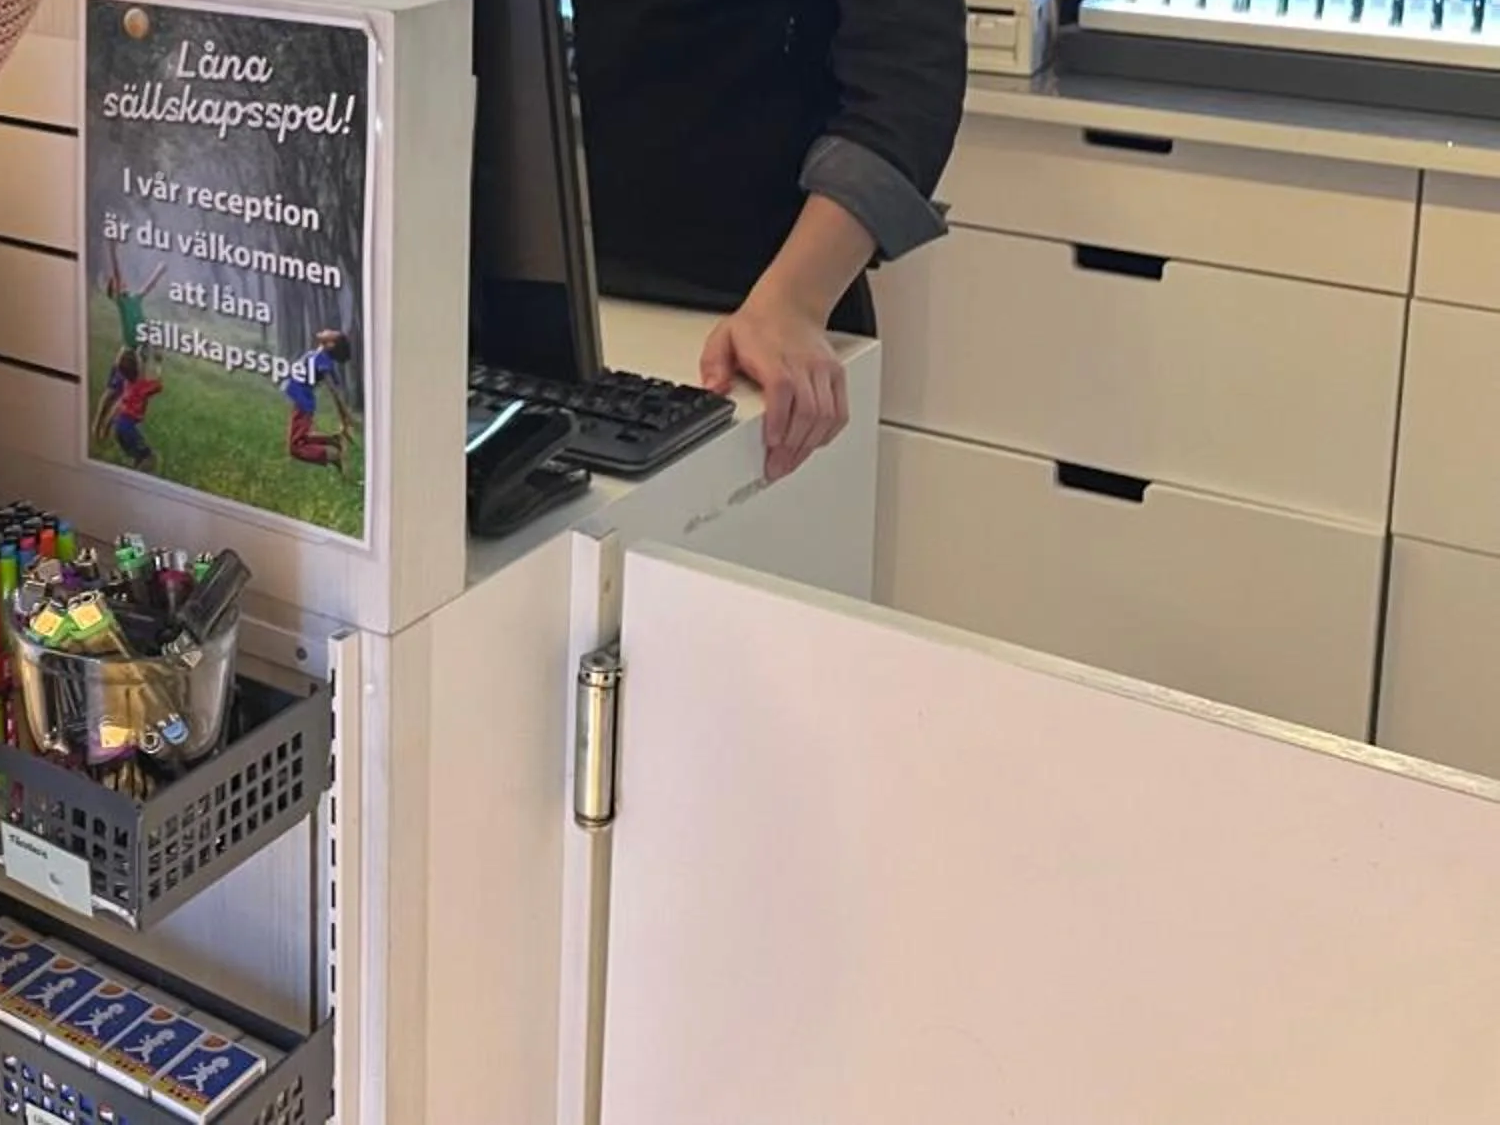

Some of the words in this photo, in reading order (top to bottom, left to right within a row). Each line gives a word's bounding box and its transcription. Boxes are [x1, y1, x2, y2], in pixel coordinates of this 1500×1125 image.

[175, 40, 273, 83] Låna
[103, 81, 356, 144] sällskapsspel!
[123, 167, 131, 194] I
[137, 170, 180, 203] vår
[187, 185, 320, 232] reception
[103, 213, 130, 242] är
[136, 220, 170, 251] du
[177, 230, 342, 289] välkommen
[168, 281, 207, 309] att
[213, 283, 271, 323] låna
[135, 318, 316, 386] sällskapsspel
